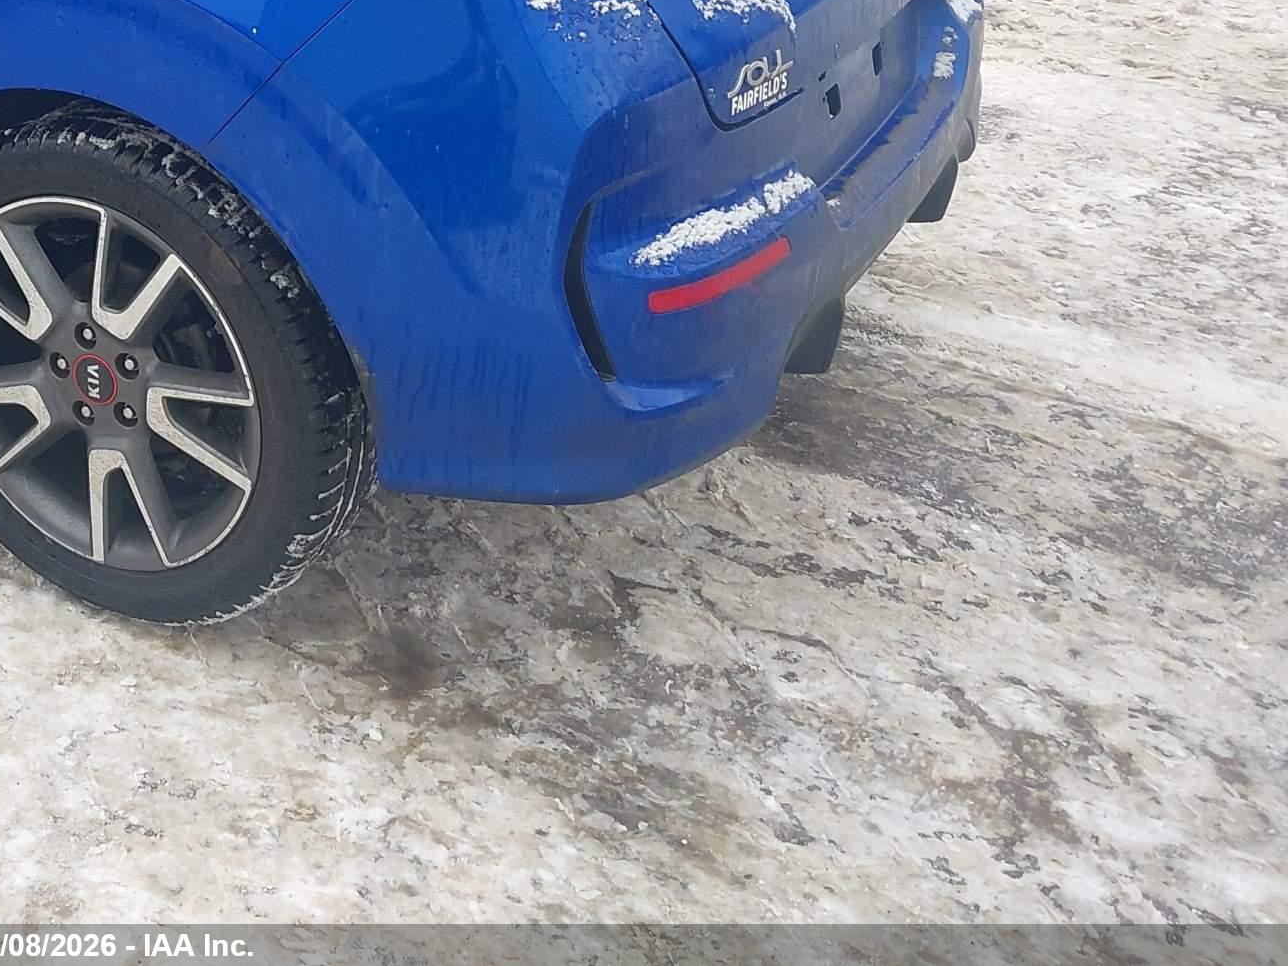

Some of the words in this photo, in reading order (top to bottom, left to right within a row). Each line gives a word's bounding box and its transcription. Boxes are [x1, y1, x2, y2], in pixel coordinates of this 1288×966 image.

[727, 48, 794, 99] SOUL
[731, 71, 788, 116] FAIRFIELD'S
[86, 364, 101, 400] KIA
